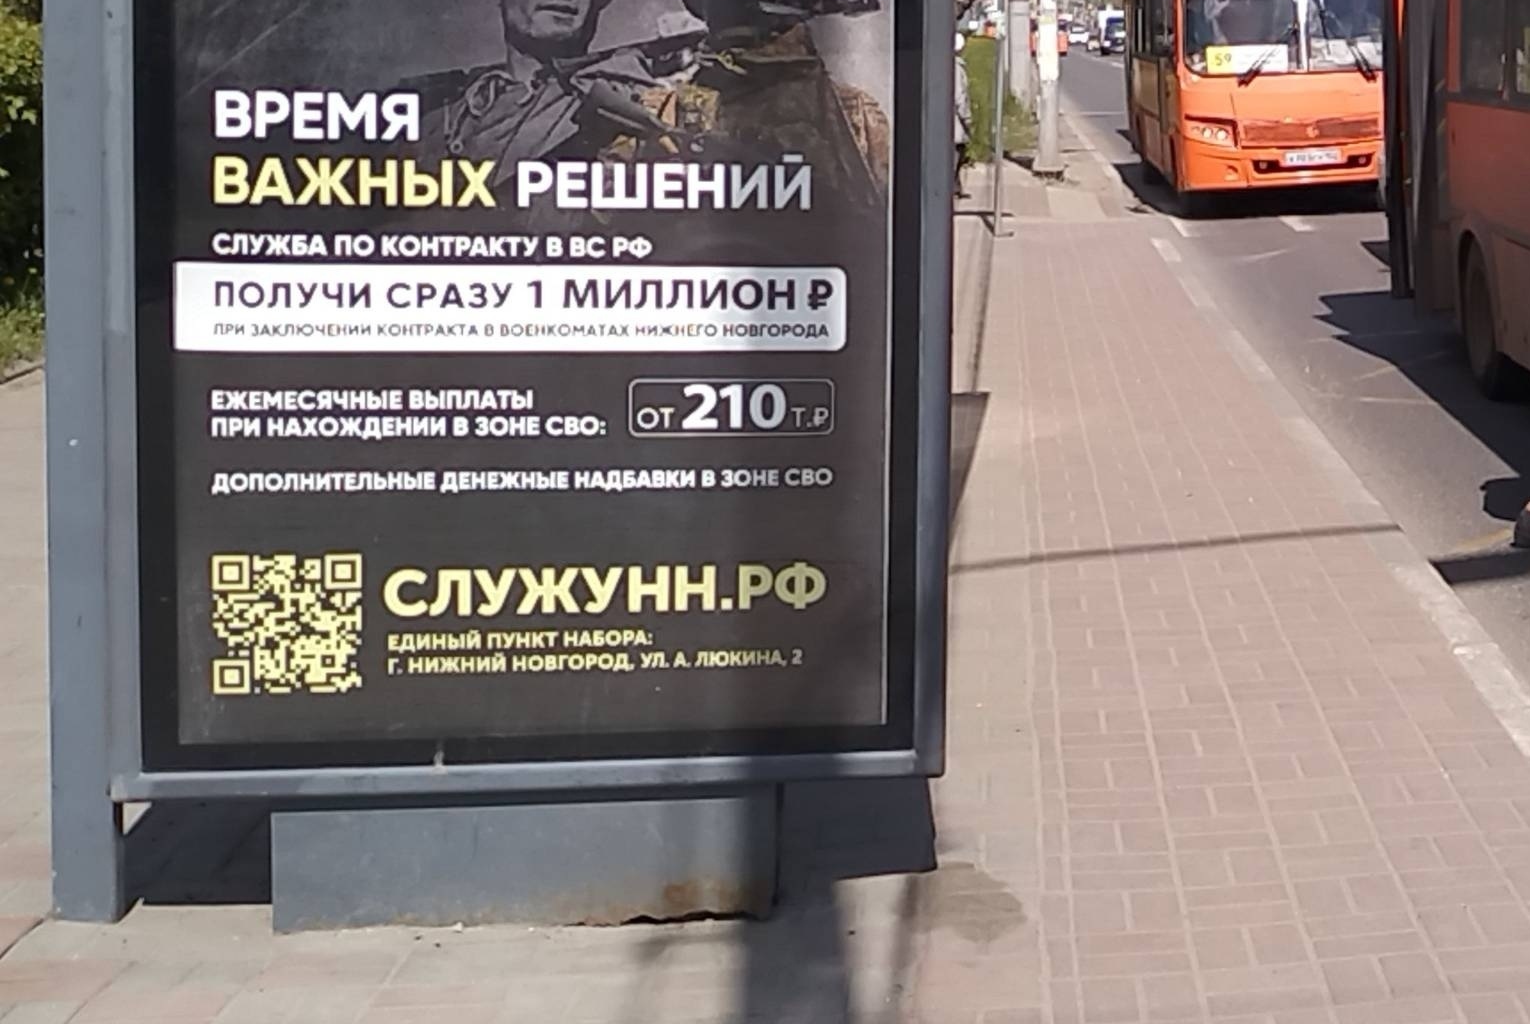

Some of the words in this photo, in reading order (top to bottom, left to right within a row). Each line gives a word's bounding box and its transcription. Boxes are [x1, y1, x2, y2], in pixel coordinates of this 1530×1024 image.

[215, 90, 420, 141] ВРЕМЯ
[214, 156, 496, 207] ВАЖНЫХ
[517, 154, 811, 209] РЕШЕНИЙ
[212, 232, 328, 257] СЛУЖБА
[334, 234, 375, 257] ПО
[381, 234, 539, 257] КОНТРАКТУ
[546, 236, 564, 257] В
[569, 236, 606, 259] ВС
[612, 236, 653, 259] РФ
[214, 280, 371, 309] ПОЛУЧИ
[386, 282, 513, 309] СРАЗУ
[527, 280, 543, 309] 1
[563, 278, 796, 311] МИЛЛИОН
[213, 322, 245, 336] ПРИ
[251, 323, 372, 337] ЗАКЛЮЧЕНИИ
[377, 323, 479, 337] КОНТРАКТА
[483, 323, 495, 337] В
[499, 323, 630, 337] ВОЕНКОМАТАХ
[635, 323, 718, 338] НИЖНЕГО
[722, 322, 830, 340] НОВГОРОДА
[211, 389, 403, 411] ЕЖЕМЕСЯЧНЫЕ
[408, 389, 534, 410] ВЫПЛАТЫ
[636, 407, 675, 430] ОТ
[681, 382, 787, 431] 210
[211, 416, 261, 437] ПРИ
[267, 416, 447, 440] НАХОЖДЕНИИ
[452, 416, 469, 437] В
[474, 415, 541, 437] ЗОНЕ
[545, 415, 606, 436] СВО:
[211, 471, 436, 495] ДОПОЛНИТЕЛЬНЫЕ
[439, 470, 569, 494] ДЕНЕЖНЫЕ
[574, 469, 696, 492] НАДБАВКИ
[701, 469, 716, 488] В
[720, 469, 779, 488] ЗОНЕ
[784, 467, 833, 487] СВО
[383, 561, 827, 617] СЛУЖУНН.РФ
[387, 629, 482, 654] ЕДИНЫЙ
[487, 631, 559, 650] ПУНКТ
[563, 629, 653, 648] НАБОРА:
[387, 658, 403, 675] Г.
[407, 649, 507, 674] НИЖНИЙ
[640, 651, 670, 669] УЛ.
[673, 651, 691, 668] А.
[791, 648, 803, 665] 2
